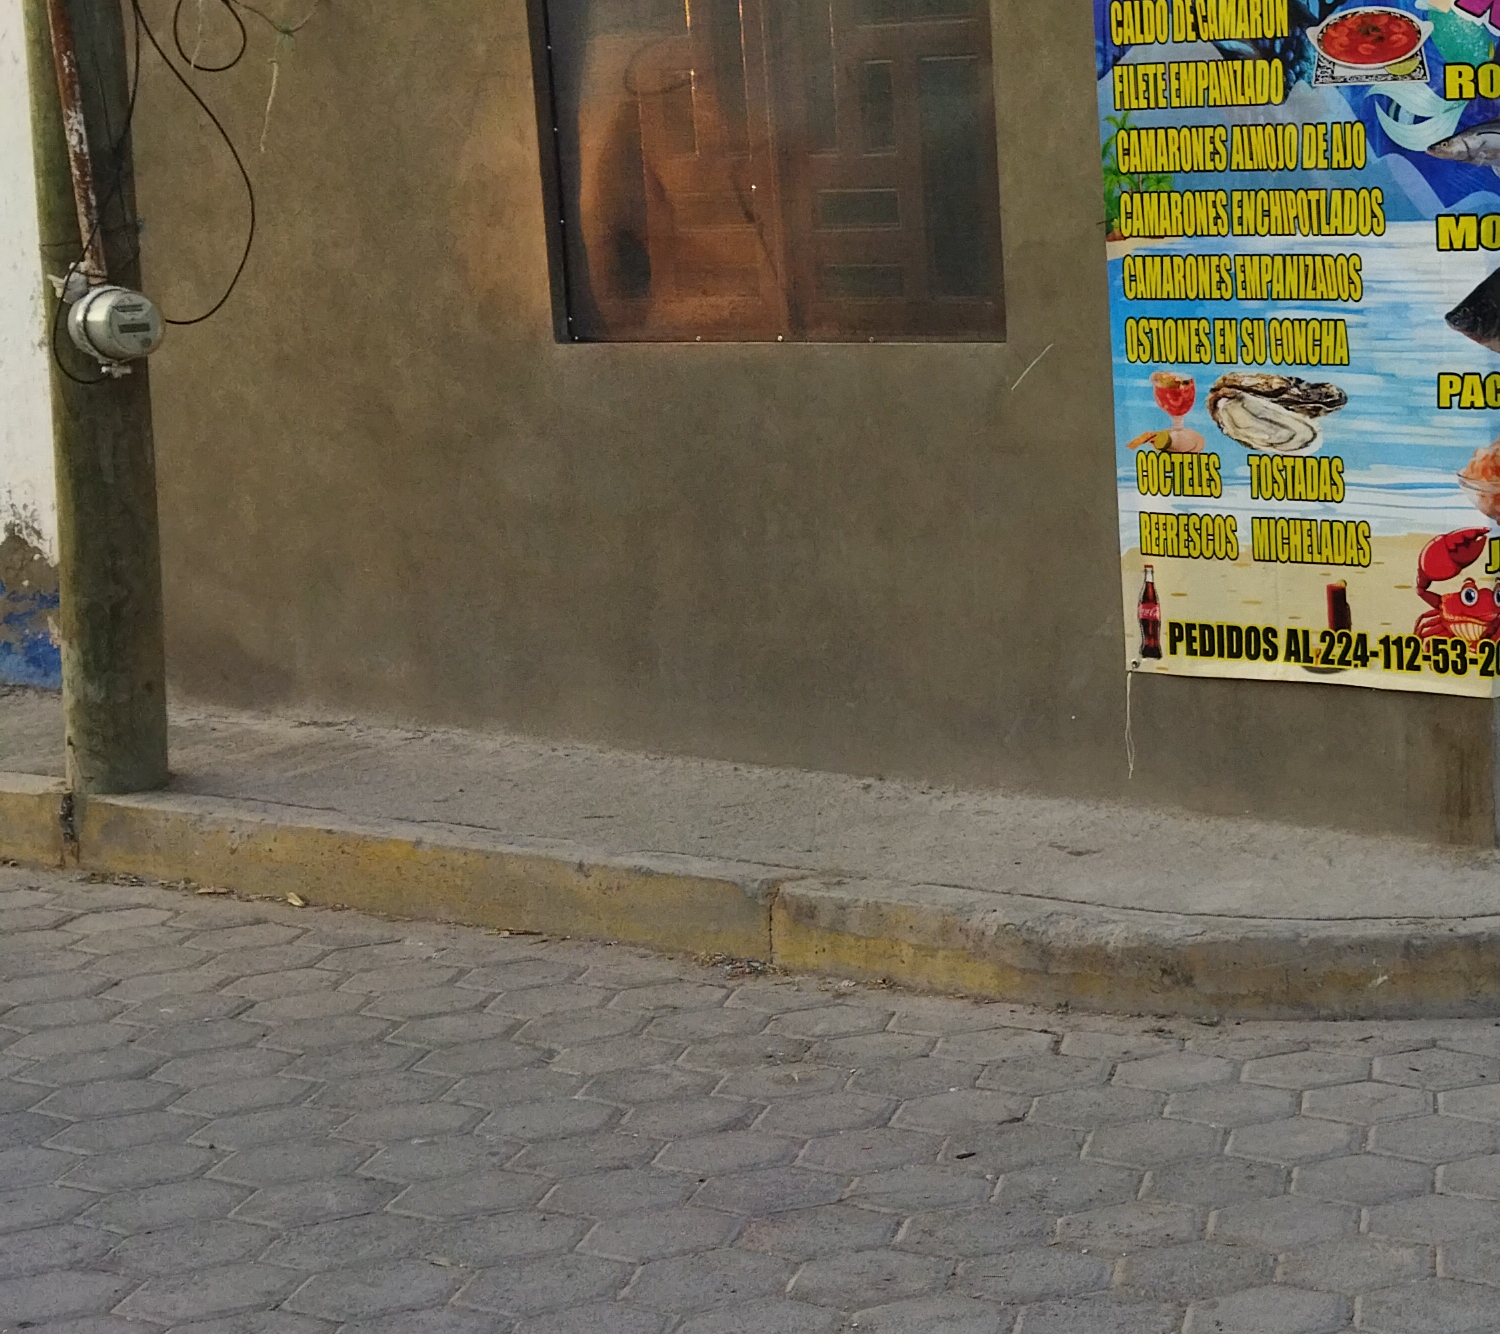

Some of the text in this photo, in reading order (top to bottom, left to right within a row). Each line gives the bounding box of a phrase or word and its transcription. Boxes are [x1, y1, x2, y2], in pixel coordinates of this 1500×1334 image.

[1113, 58, 1284, 110] FILETE EMPANIZADO
[1116, 124, 1228, 174] CAMARONES
[1302, 122, 1329, 170] DE
[1330, 121, 1367, 170] AJO
[1119, 187, 1386, 238] CAMARONES ENCHIPOTLADOS
[1122, 253, 1363, 302] CAMARONES EMPANIZADOS
[1125, 316, 1350, 366] OSTIONES EN SU CONCHA
[1136, 450, 1345, 503] COCTELES TOSTADAS
[1139, 511, 1372, 568] REFRESCOS MICHELADAS
[1167, 619, 1280, 663] PEDIDOS
[1282, 626, 1316, 666] AL
